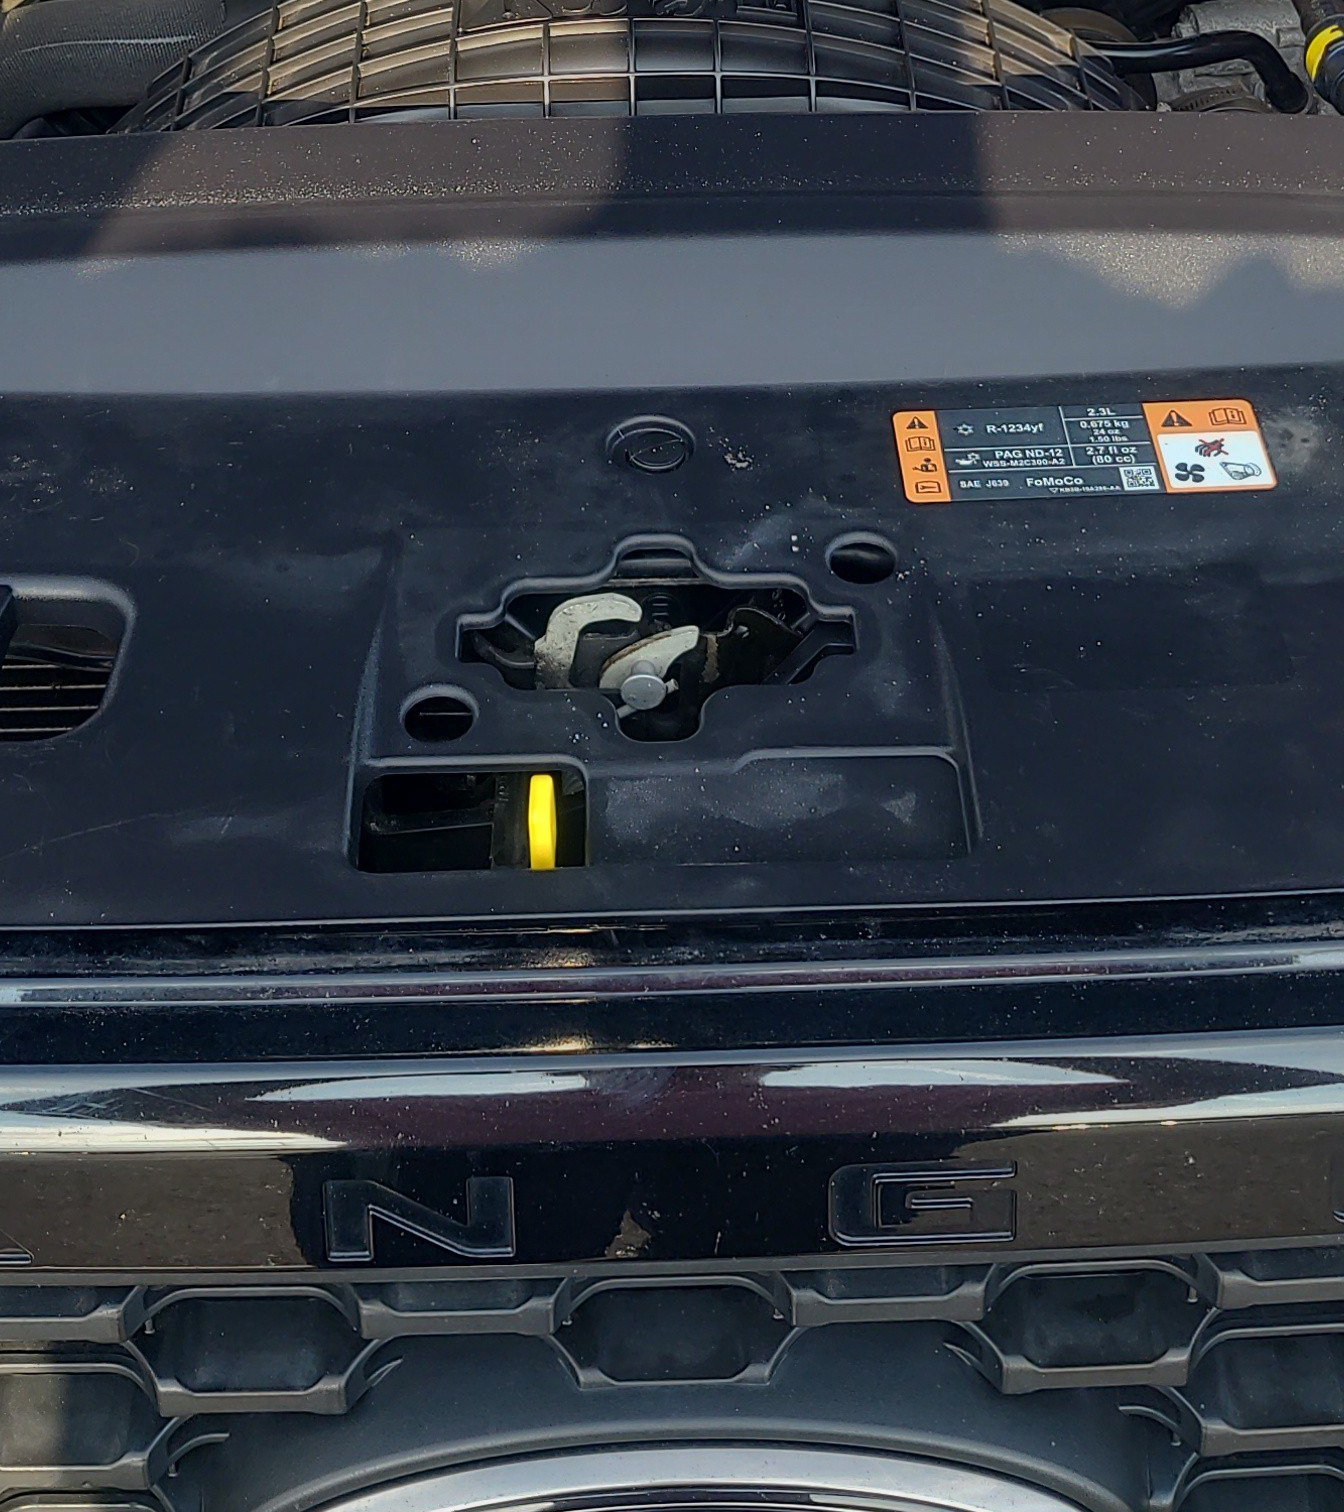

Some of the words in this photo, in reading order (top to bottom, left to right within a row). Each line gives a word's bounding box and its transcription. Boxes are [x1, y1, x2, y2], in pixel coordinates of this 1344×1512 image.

[1086, 407, 1116, 417] 2.3L
[986, 422, 1044, 434] R-1234yf
[1113, 419, 1130, 429] kg
[994, 449, 1023, 459] PAG
[1025, 448, 1064, 459] ND-12
[1085, 446, 1104, 455] 2.7
[1108, 446, 1118, 454] fl
[1121, 446, 1138, 454] oz
[1092, 455, 1112, 466] (80
[1115, 454, 1136, 464] cc)
[959, 480, 981, 488] SAE
[1026, 476, 1084, 487] FoMoCo
